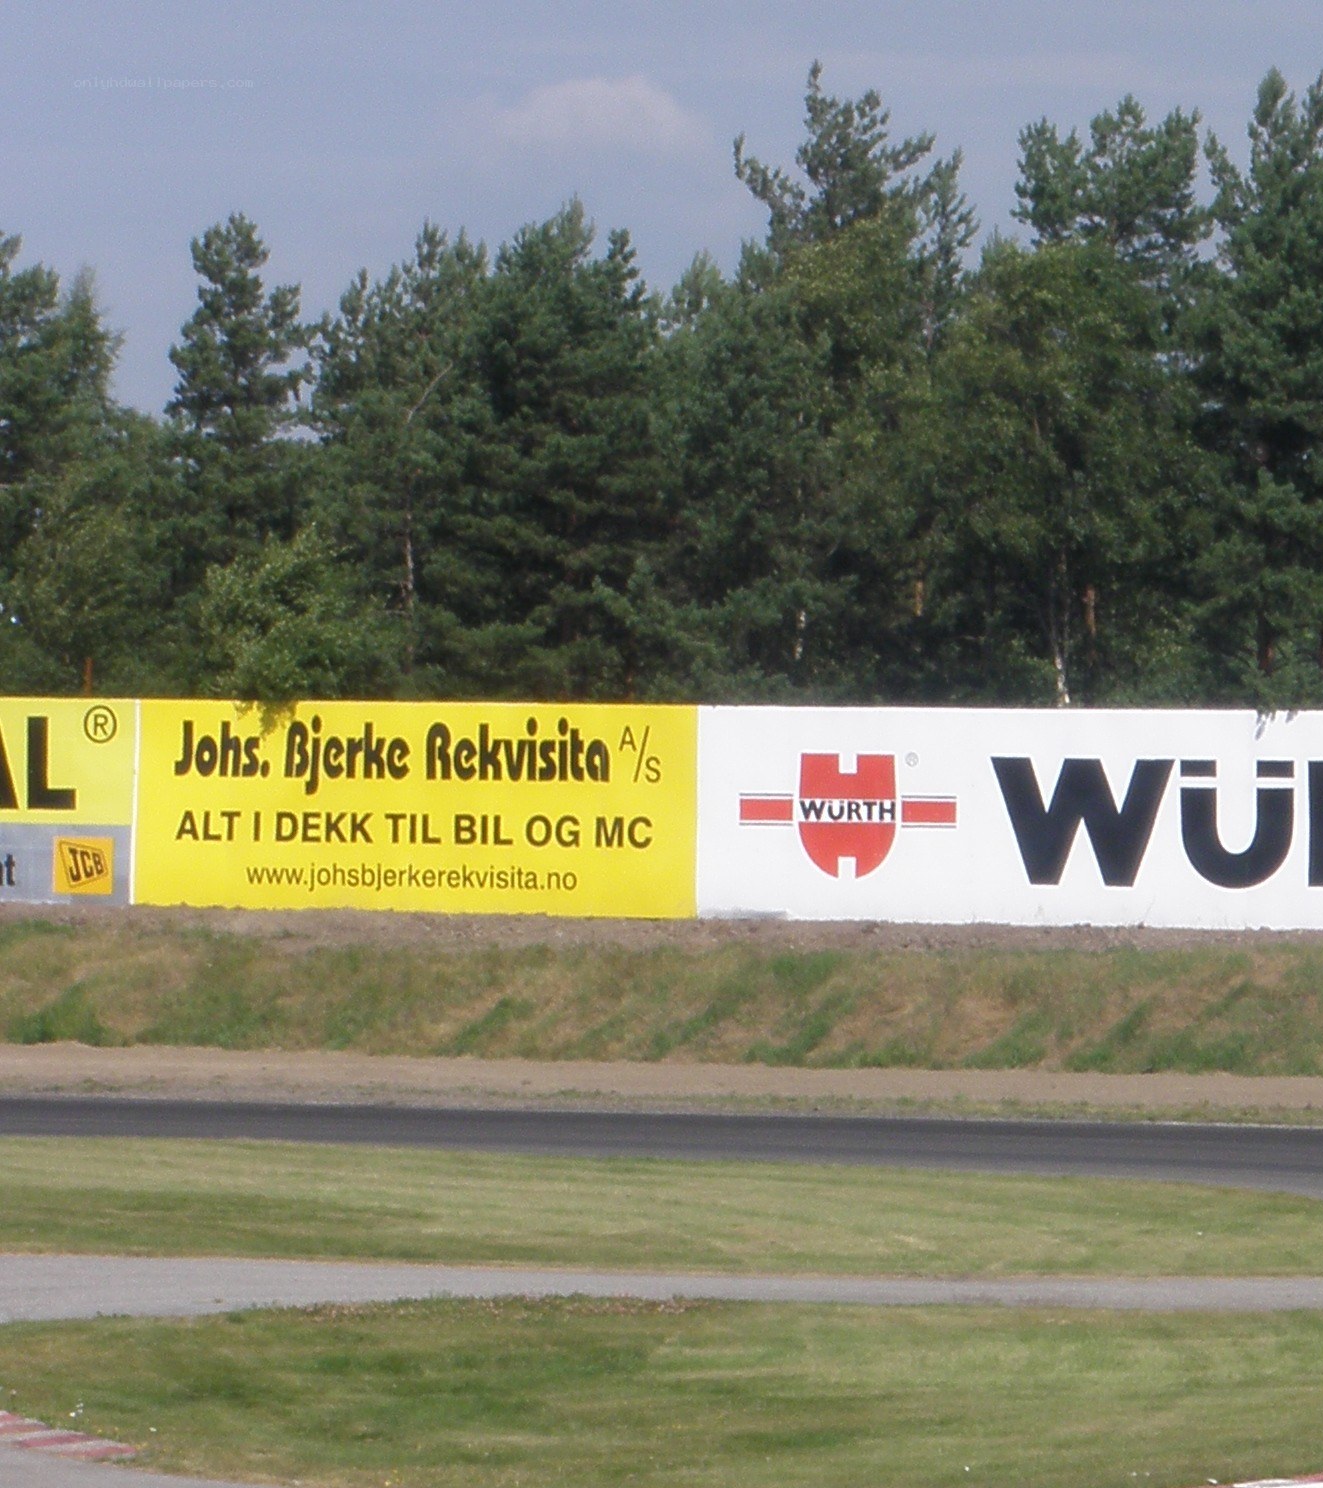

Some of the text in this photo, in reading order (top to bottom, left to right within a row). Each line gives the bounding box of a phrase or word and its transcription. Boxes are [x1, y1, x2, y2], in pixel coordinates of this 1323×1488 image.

[174, 714, 661, 795] Johs. Bjerke Rekvisita A/S
[801, 800, 895, 821] WÜRTH
[176, 811, 653, 849] ALT I DEKK TIL BIL OG MC
[68, 847, 104, 883] JCB
[247, 863, 577, 892] www.johsbjerkerekvisita.no
